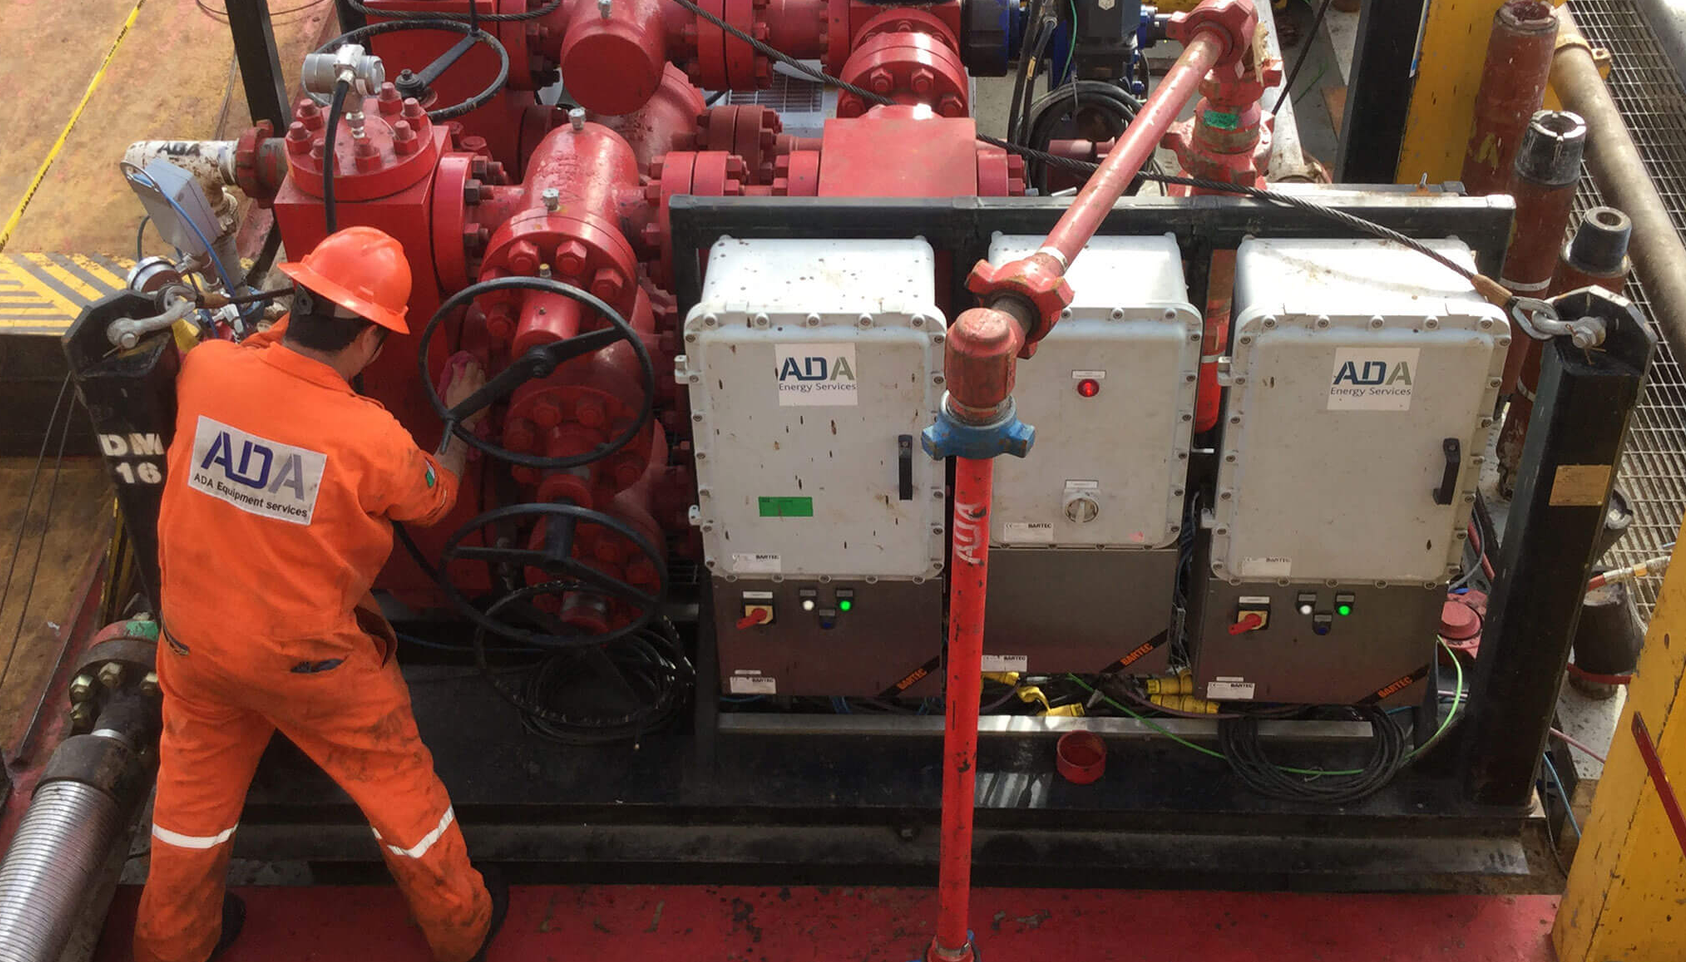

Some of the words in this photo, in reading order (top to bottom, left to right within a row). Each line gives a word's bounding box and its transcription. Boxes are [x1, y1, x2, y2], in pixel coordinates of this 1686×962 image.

[779, 356, 856, 381] ADA
[1333, 360, 1412, 386] ADA
[778, 382, 813, 393] Energy
[815, 382, 857, 391] Services
[1330, 386, 1366, 397] Energy
[1368, 386, 1412, 396] Services
[99, 433, 165, 456] DM
[115, 461, 162, 484] 16
[200, 430, 305, 501] ADA
[194, 472, 214, 489] ADA
[216, 481, 264, 508] Equipment
[265, 501, 308, 518] services
[1120, 642, 1154, 667] BARTEC
[896, 668, 928, 691] BARTEC
[1377, 676, 1413, 699] BARTEC
